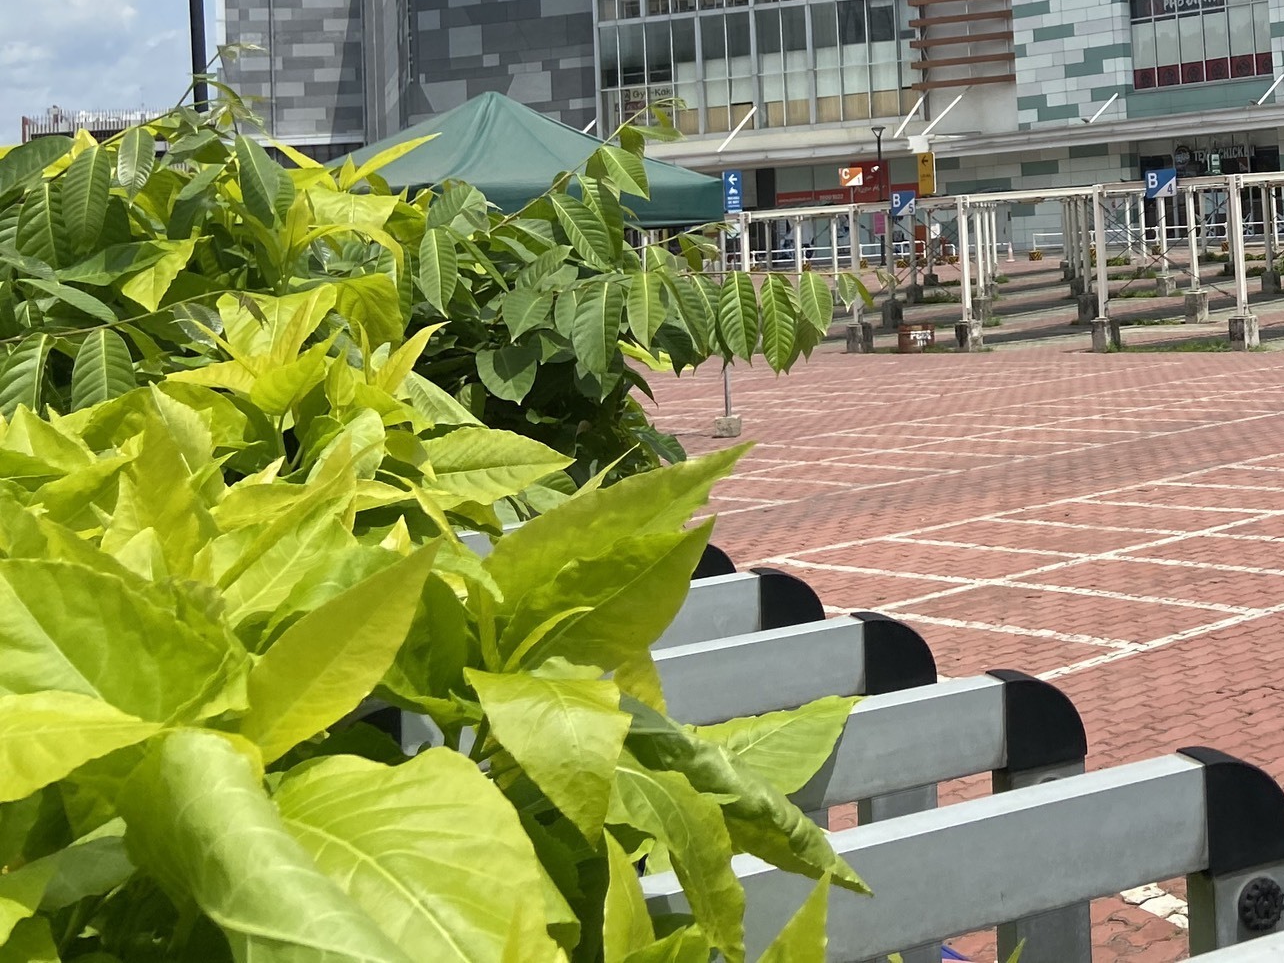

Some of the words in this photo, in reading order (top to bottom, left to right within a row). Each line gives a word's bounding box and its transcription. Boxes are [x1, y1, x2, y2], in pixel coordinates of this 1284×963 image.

[841, 167, 850, 180] C
[1147, 172, 1158, 189] B
[1166, 183, 1173, 194] 4
[892, 193, 901, 208] B
[908, 203, 914, 214] 5
